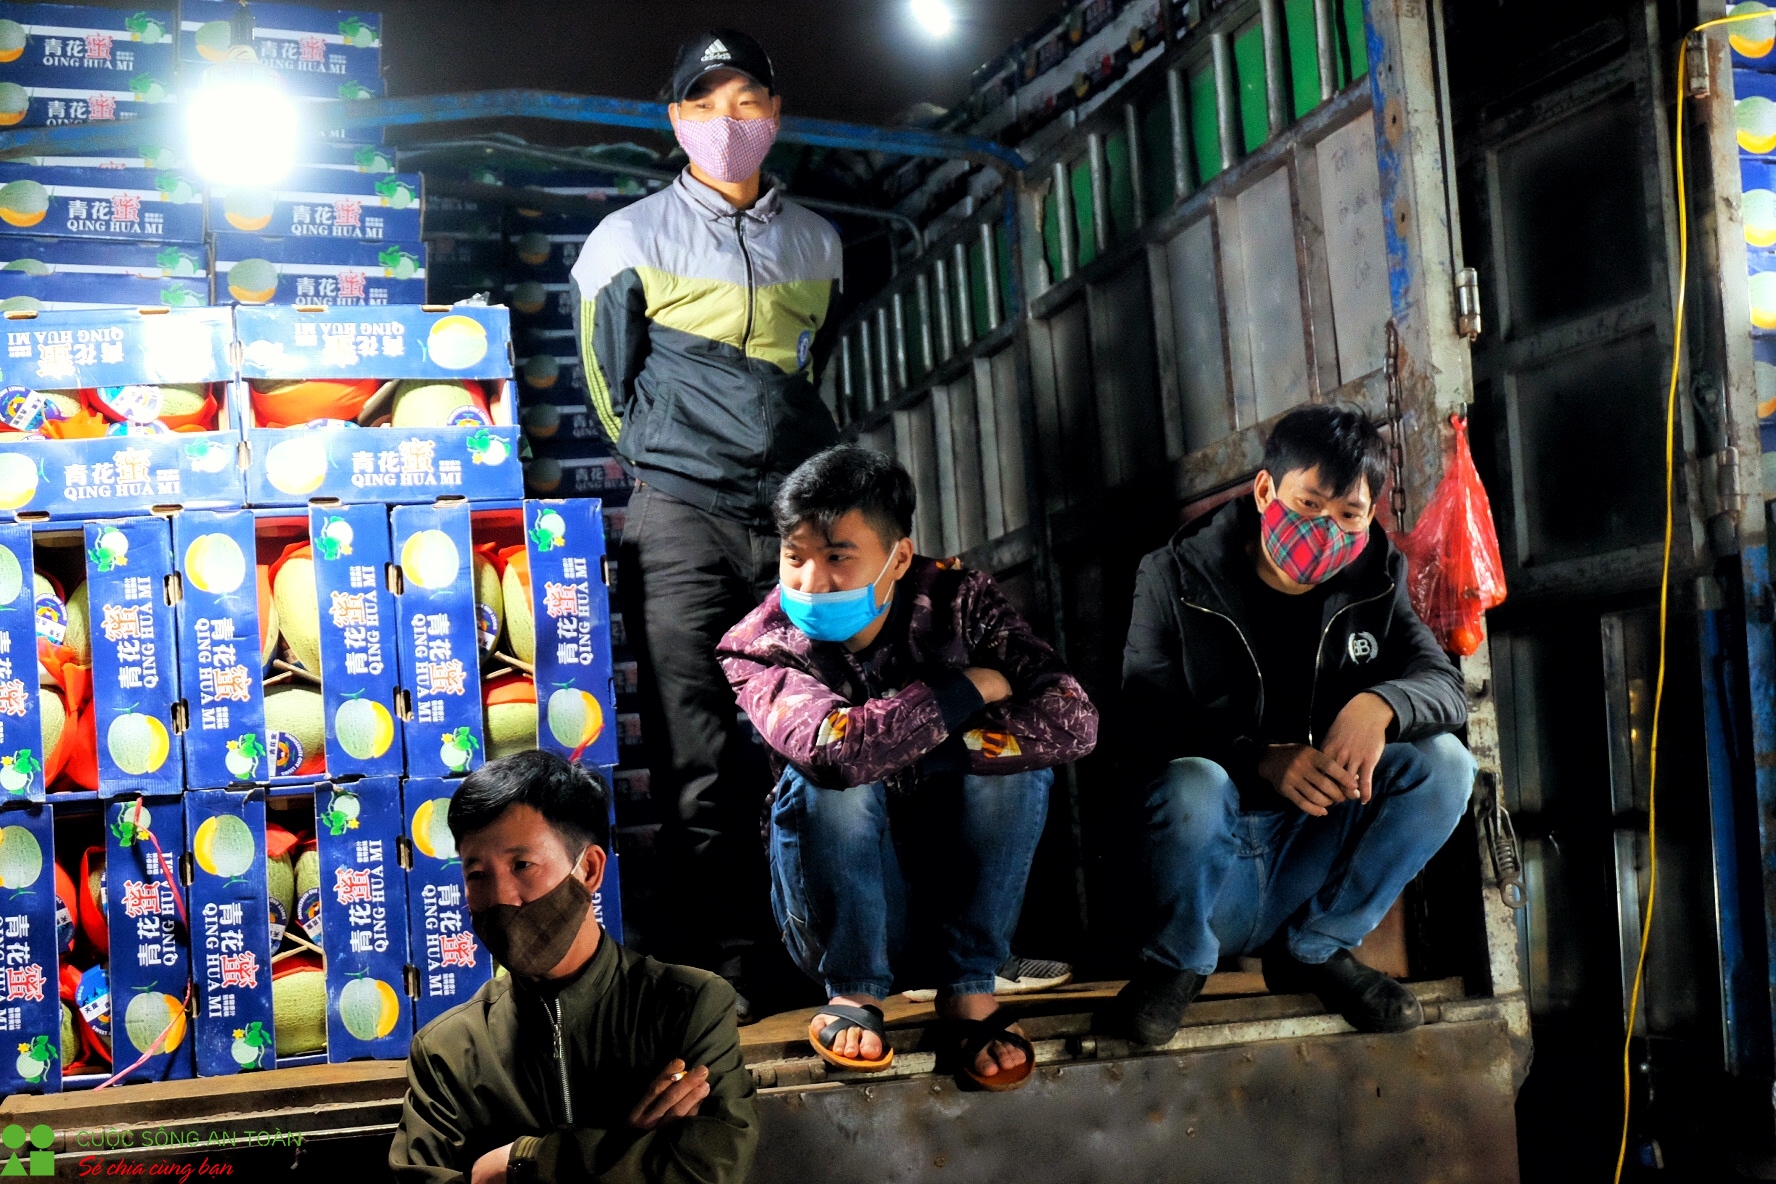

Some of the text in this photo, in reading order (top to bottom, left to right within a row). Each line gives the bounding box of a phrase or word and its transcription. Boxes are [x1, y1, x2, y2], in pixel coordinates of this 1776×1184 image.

[43, 57, 134, 71] QING HUA MI
[298, 61, 326, 73] HUA
[330, 64, 347, 74] MI
[66, 220, 163, 234] QING HUA MI
[291, 224, 383, 238] QING HUA MI
[34, 330, 73, 344] HUA
[77, 326, 124, 342] QING
[63, 481, 180, 500] QING HUA MI
[351, 472, 462, 488] QING HUA MI
[137, 576, 159, 688] QING HUA MI
[362, 565, 384, 675] QING HUA MI
[574, 557, 594, 665] QING HUA MI
[194, 618, 216, 730] QING HUA MI
[411, 613, 431, 723] QING HUA MI
[121, 879, 162, 967] 青花蜜
[333, 867, 374, 953] 青花蜜
[369, 839, 389, 953] QING HUA MI
[437, 883, 478, 968] 青花蜜
[591, 892, 606, 930] ING
[5, 914, 47, 1002] 青花蜜
[162, 919, 178, 966] QING
[202, 902, 222, 1018] QING HUA MI
[218, 902, 260, 989] 青花蜜
[421, 884, 443, 997] QING HUA MI
